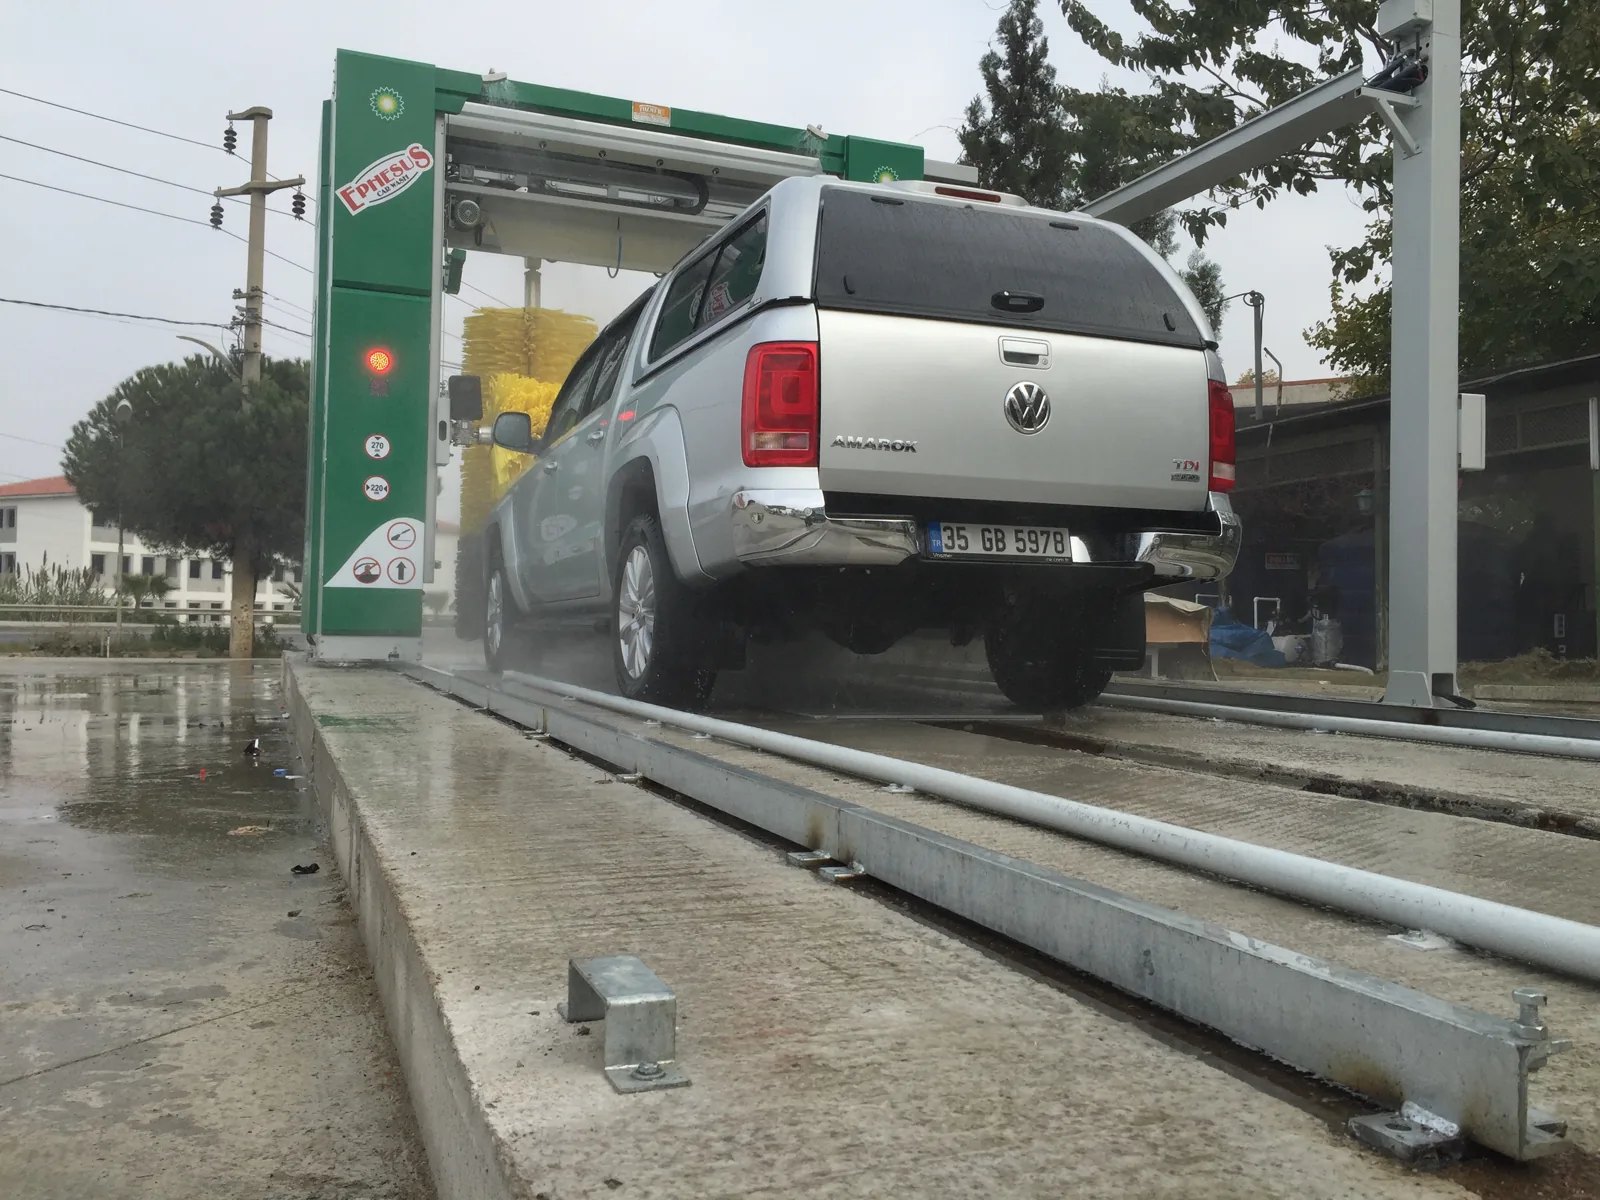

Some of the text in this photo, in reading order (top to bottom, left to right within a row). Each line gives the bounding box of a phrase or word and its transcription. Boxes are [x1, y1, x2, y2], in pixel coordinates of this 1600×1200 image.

[340, 146, 431, 211] EPHESUS
[377, 174, 410, 197] CAR WASH
[830, 435, 918, 453] AMAROK
[1172, 458, 1200, 471] TDI
[370, 484, 383, 492] 220
[932, 539, 941, 547] TR
[942, 525, 1065, 554] 35 GB 5978
